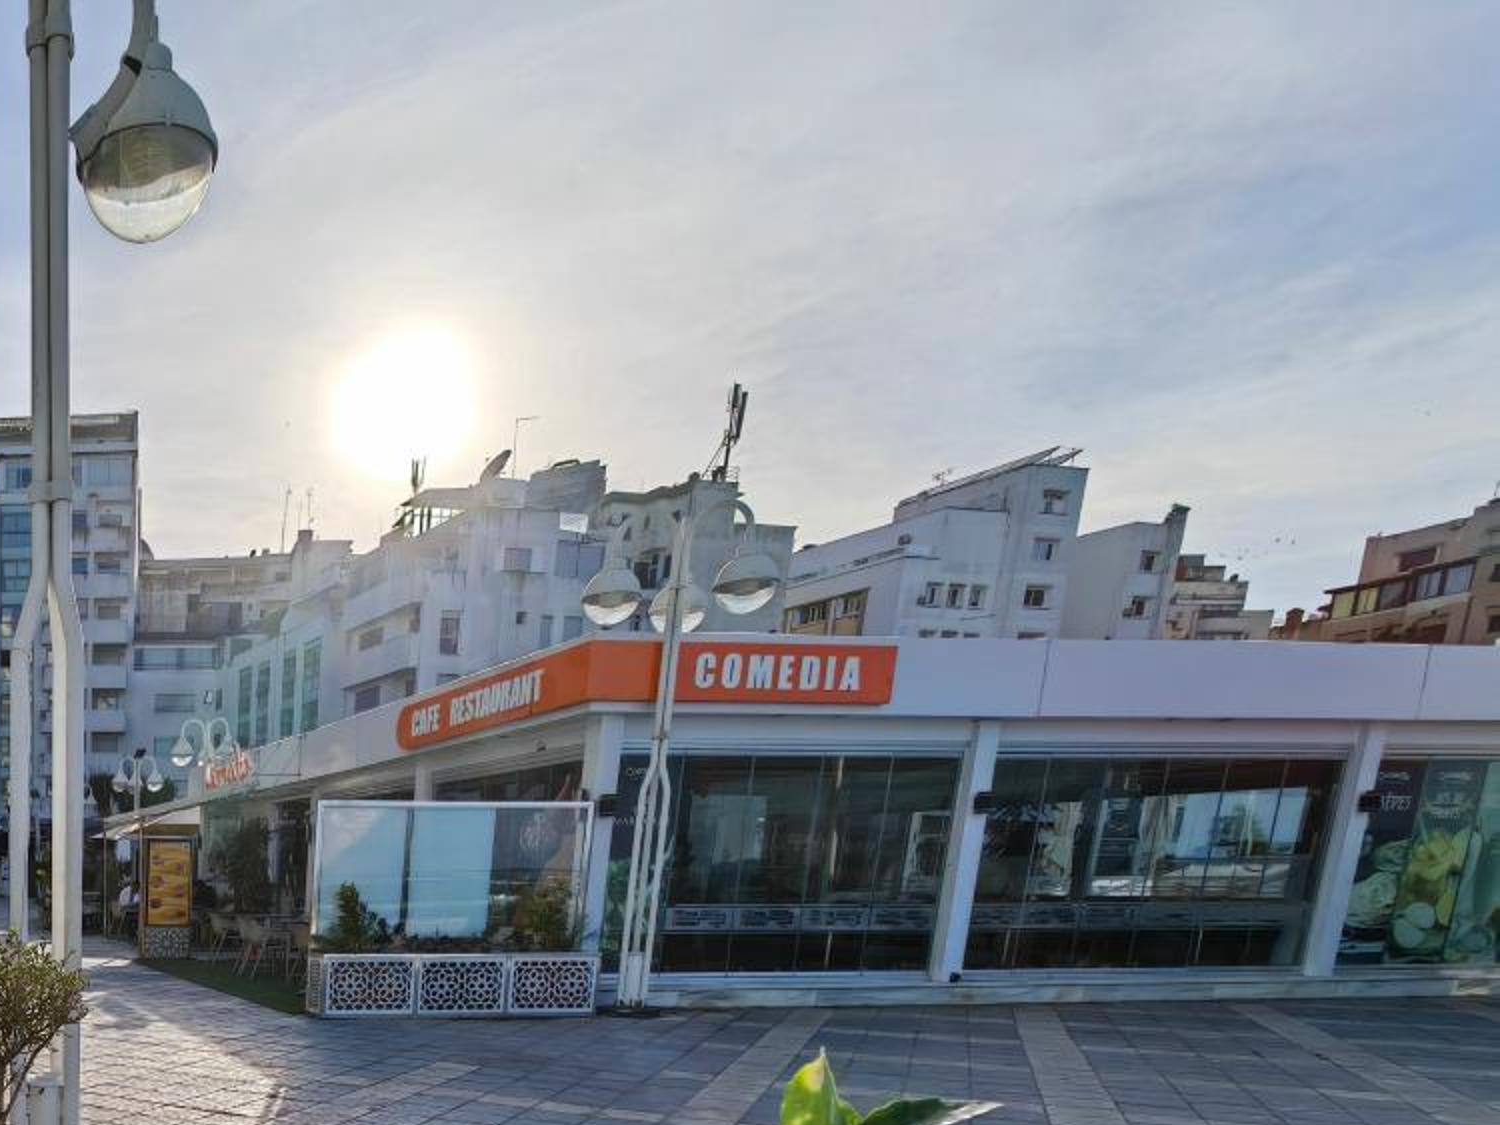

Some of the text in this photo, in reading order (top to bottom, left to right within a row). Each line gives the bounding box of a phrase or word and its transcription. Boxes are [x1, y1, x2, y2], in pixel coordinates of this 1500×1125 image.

[694, 652, 861, 691] COMEDIA
[411, 668, 546, 737] CAFE RESTAURANT
